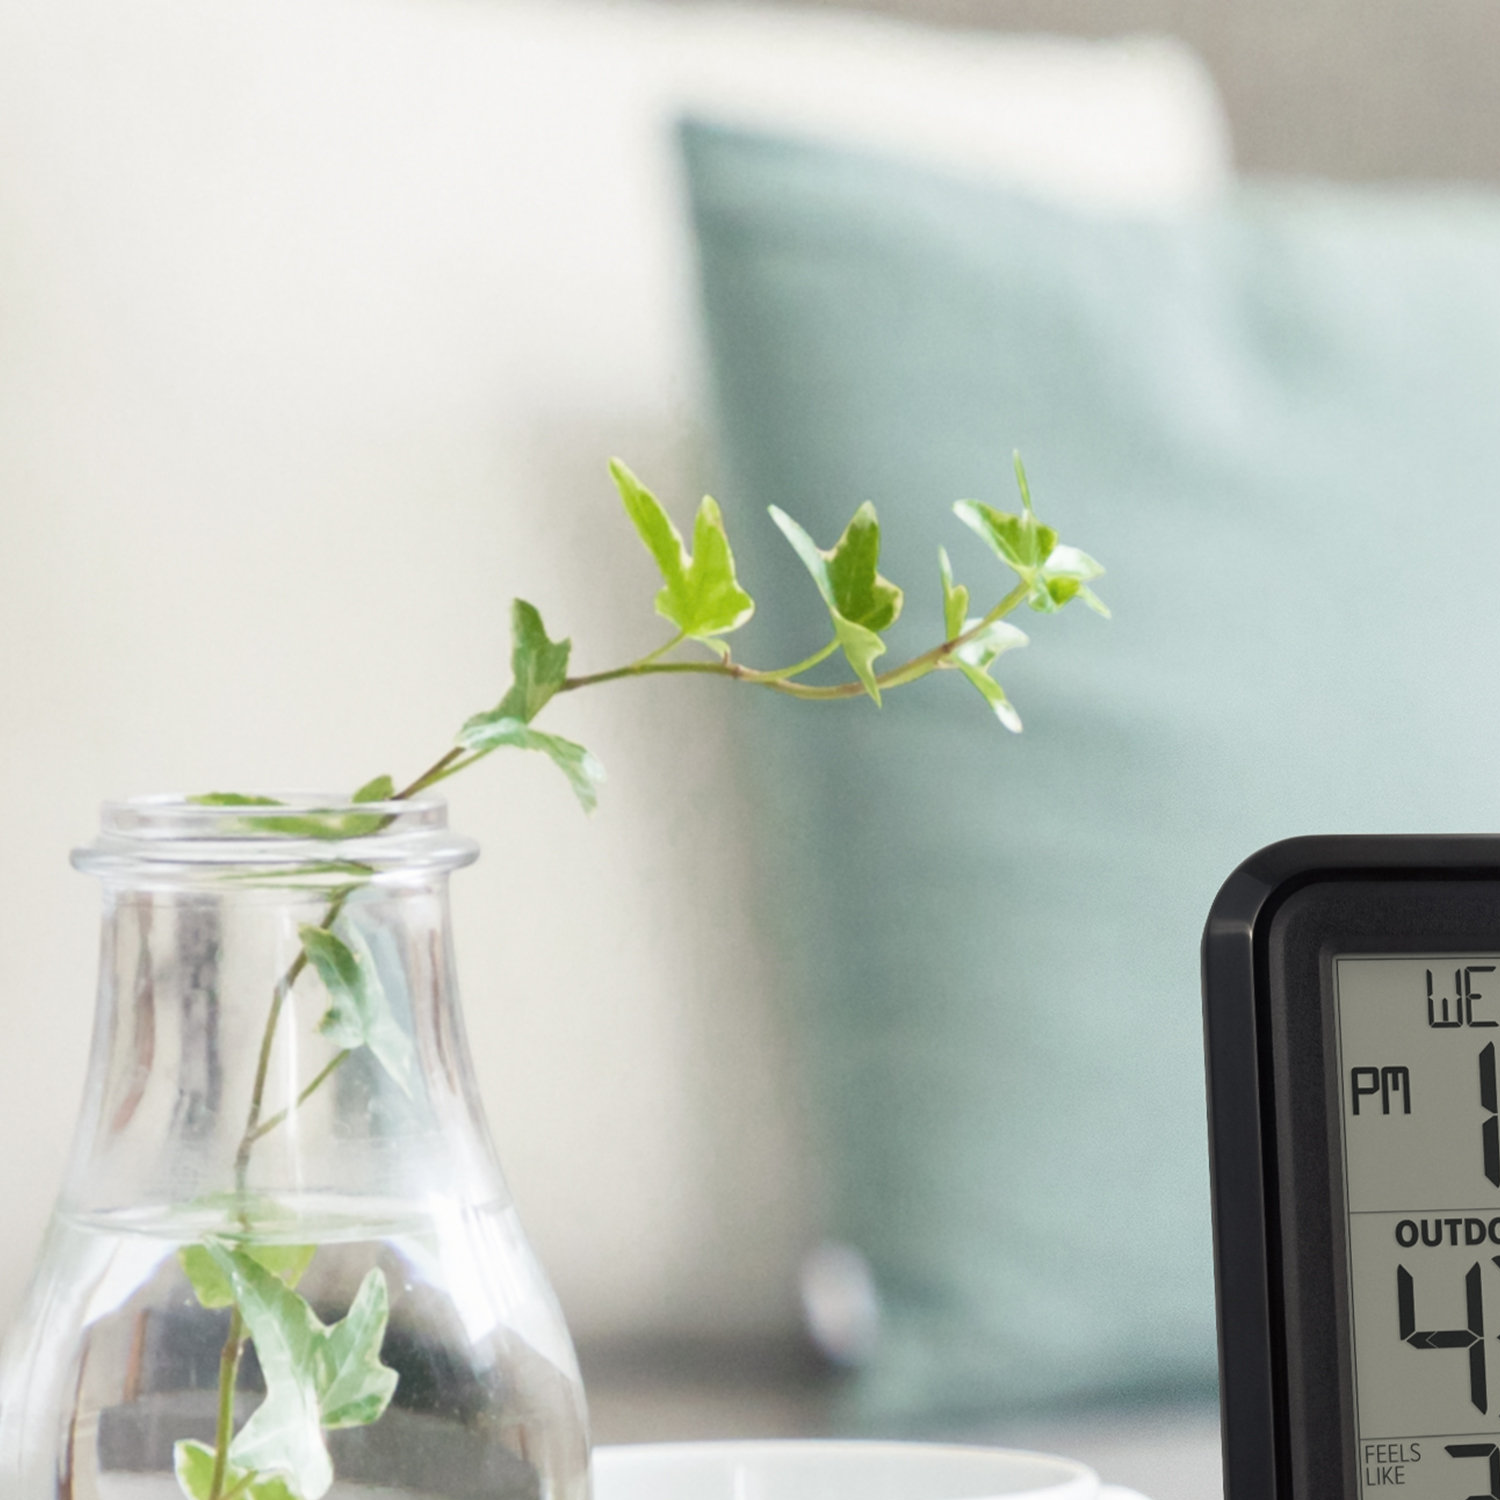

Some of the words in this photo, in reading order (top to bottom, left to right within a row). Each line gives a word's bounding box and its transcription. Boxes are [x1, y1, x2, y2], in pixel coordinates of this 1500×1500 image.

[1350, 1066, 1411, 1115] PM
[1365, 1443, 1421, 1463] FEELS
[1366, 1466, 1405, 1486] LIKE
